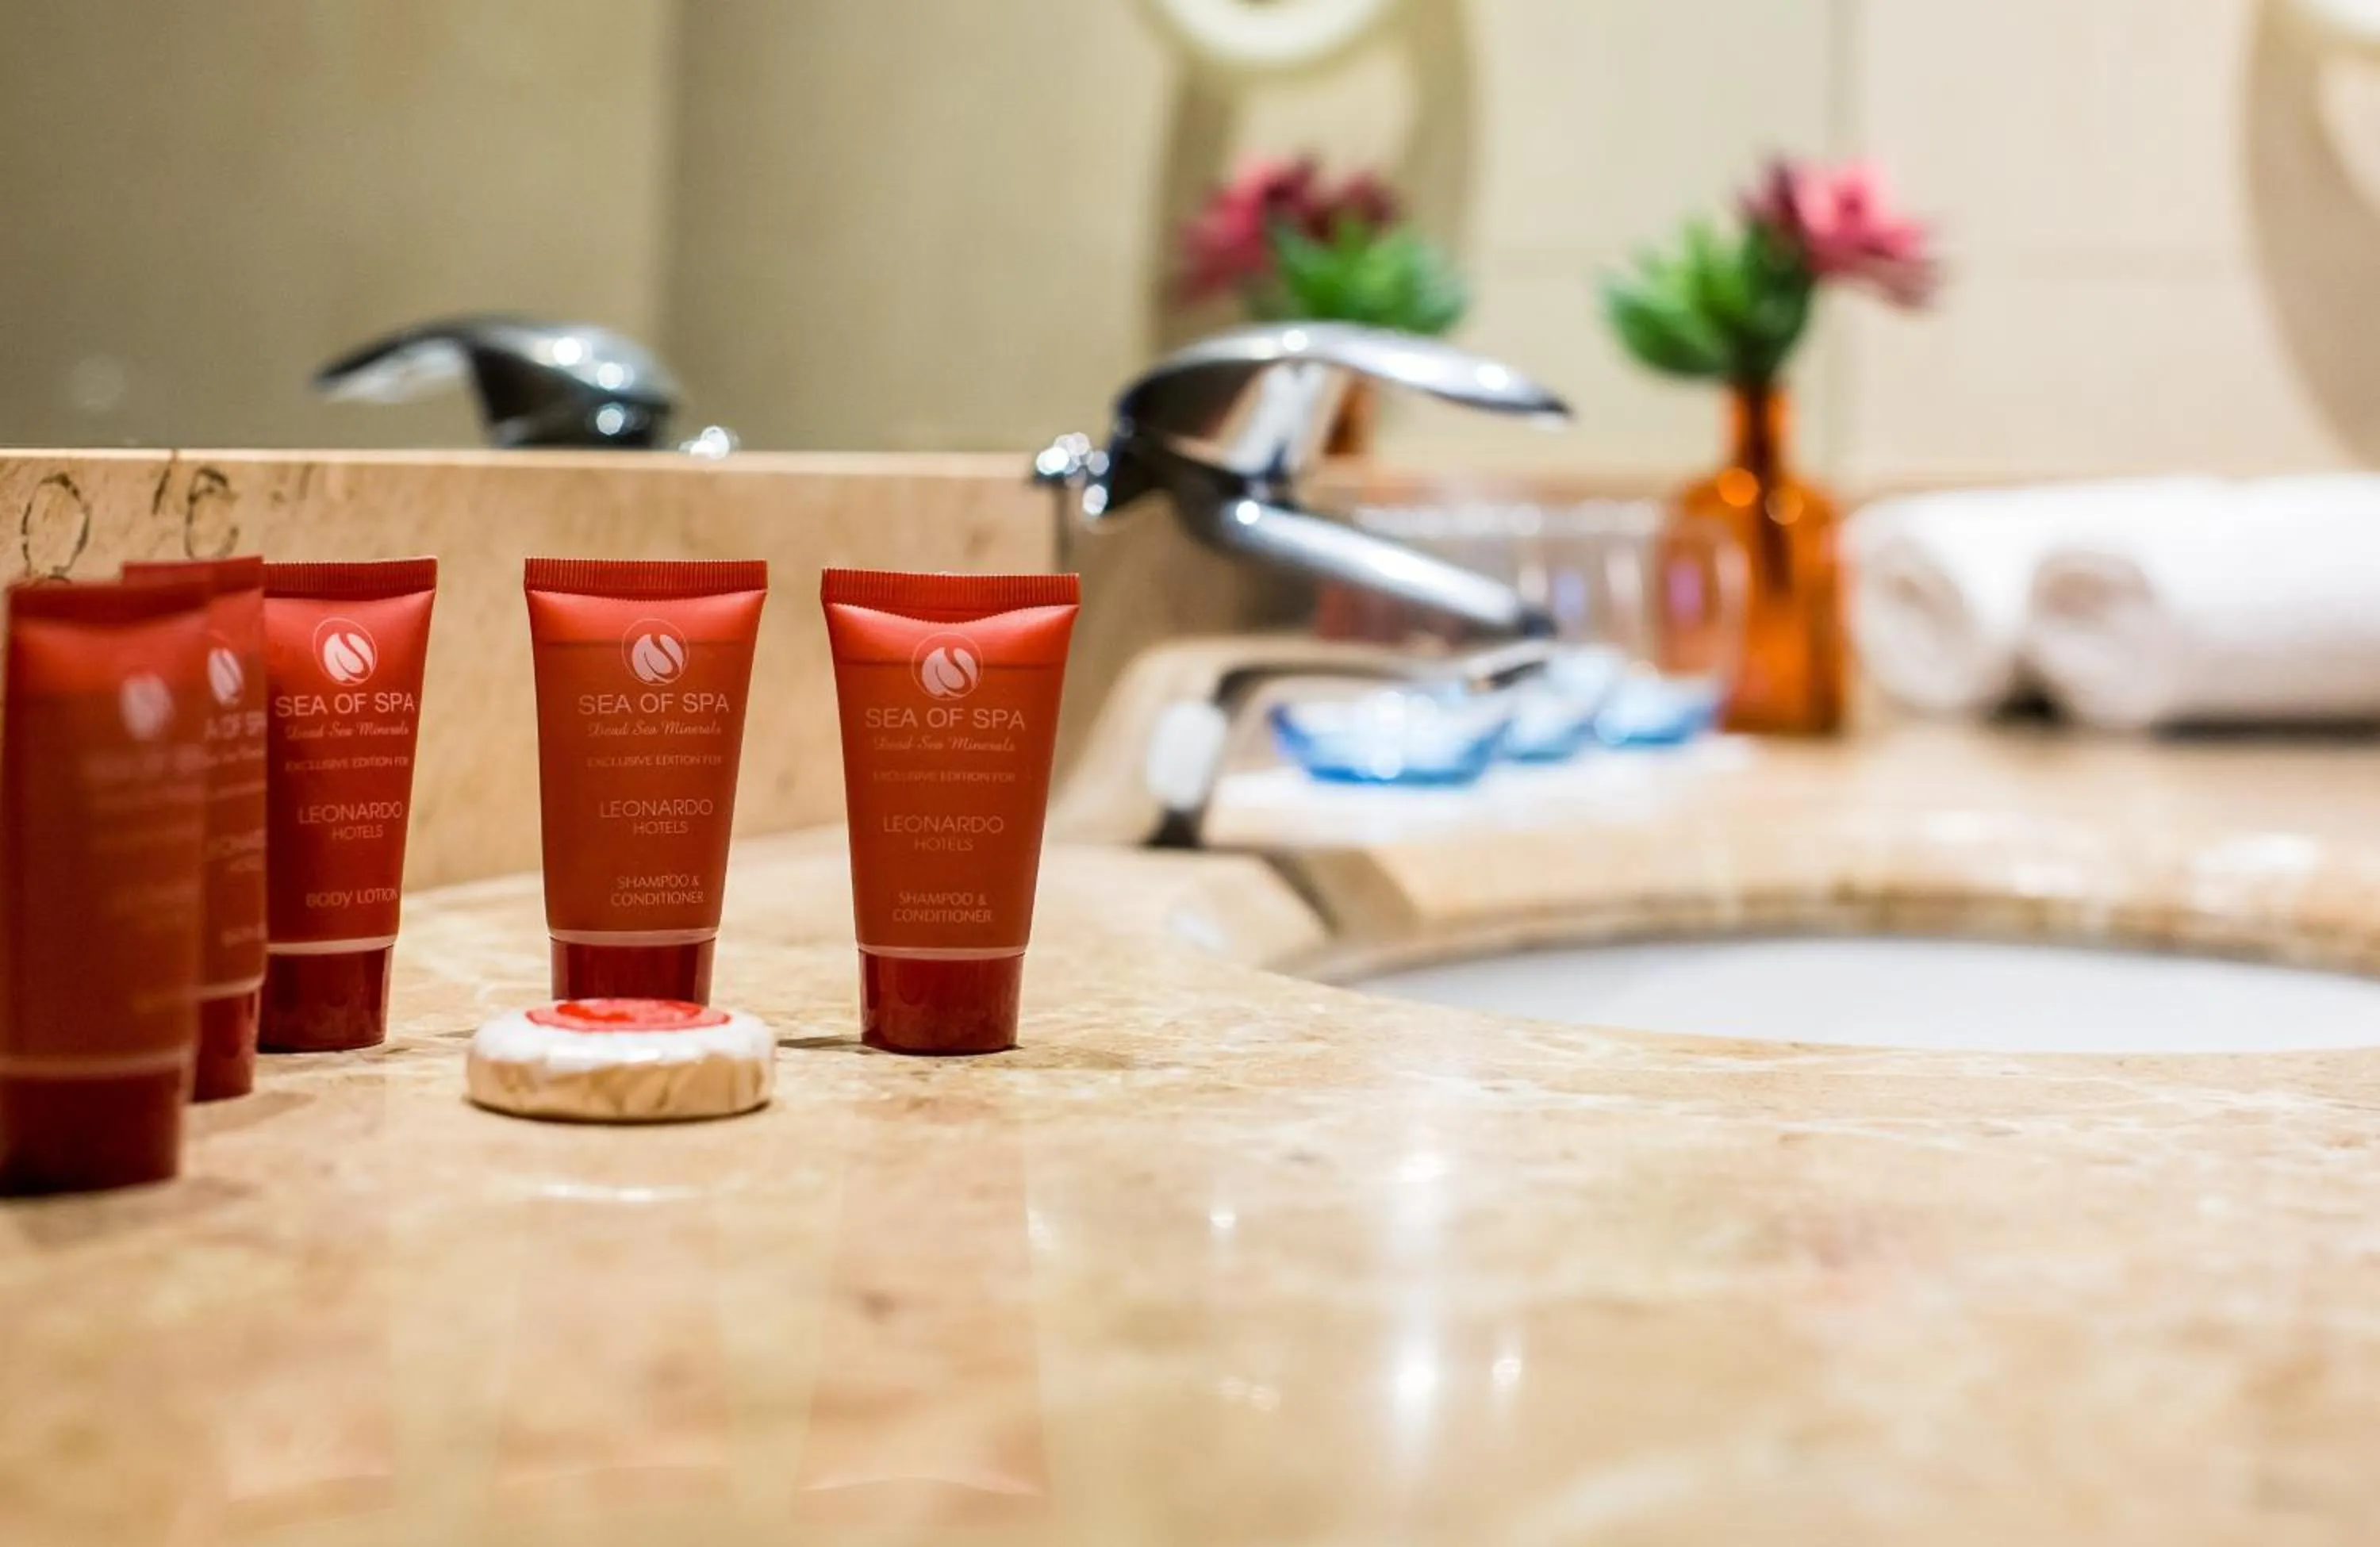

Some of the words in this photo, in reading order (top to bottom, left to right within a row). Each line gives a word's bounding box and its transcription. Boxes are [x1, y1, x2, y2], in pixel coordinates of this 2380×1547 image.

[274, 695, 328, 718] SEA
[334, 693, 367, 714] OF
[374, 692, 415, 713] SPA
[578, 693, 632, 715] SEA
[640, 693, 674, 713] OF
[682, 693, 729, 713] SPA
[865, 708, 919, 728] SEA
[926, 707, 965, 728] OF
[973, 708, 1026, 731] SPA
[328, 721, 354, 737] Sea
[587, 722, 628, 737] Dead
[634, 719, 658, 735] Sea
[661, 720, 722, 735] Minerals
[917, 735, 944, 750] Sea
[947, 735, 1015, 752] Minerals
[297, 801, 403, 824] LEONARDO
[600, 799, 714, 818] LEONARDO
[332, 824, 384, 840] HOTELS
[634, 820, 689, 835] HOTELS
[883, 815, 1004, 833] LEONARDO
[914, 837, 974, 851] HOTELS
[617, 874, 689, 889] SHAMPOO
[691, 875, 701, 887] &
[305, 890, 353, 908] BODY
[610, 891, 704, 907] CONDITIONER
[898, 891, 974, 906] SHAMPOO
[977, 893, 988, 906] &
[892, 908, 992, 923] CONDITIONER
